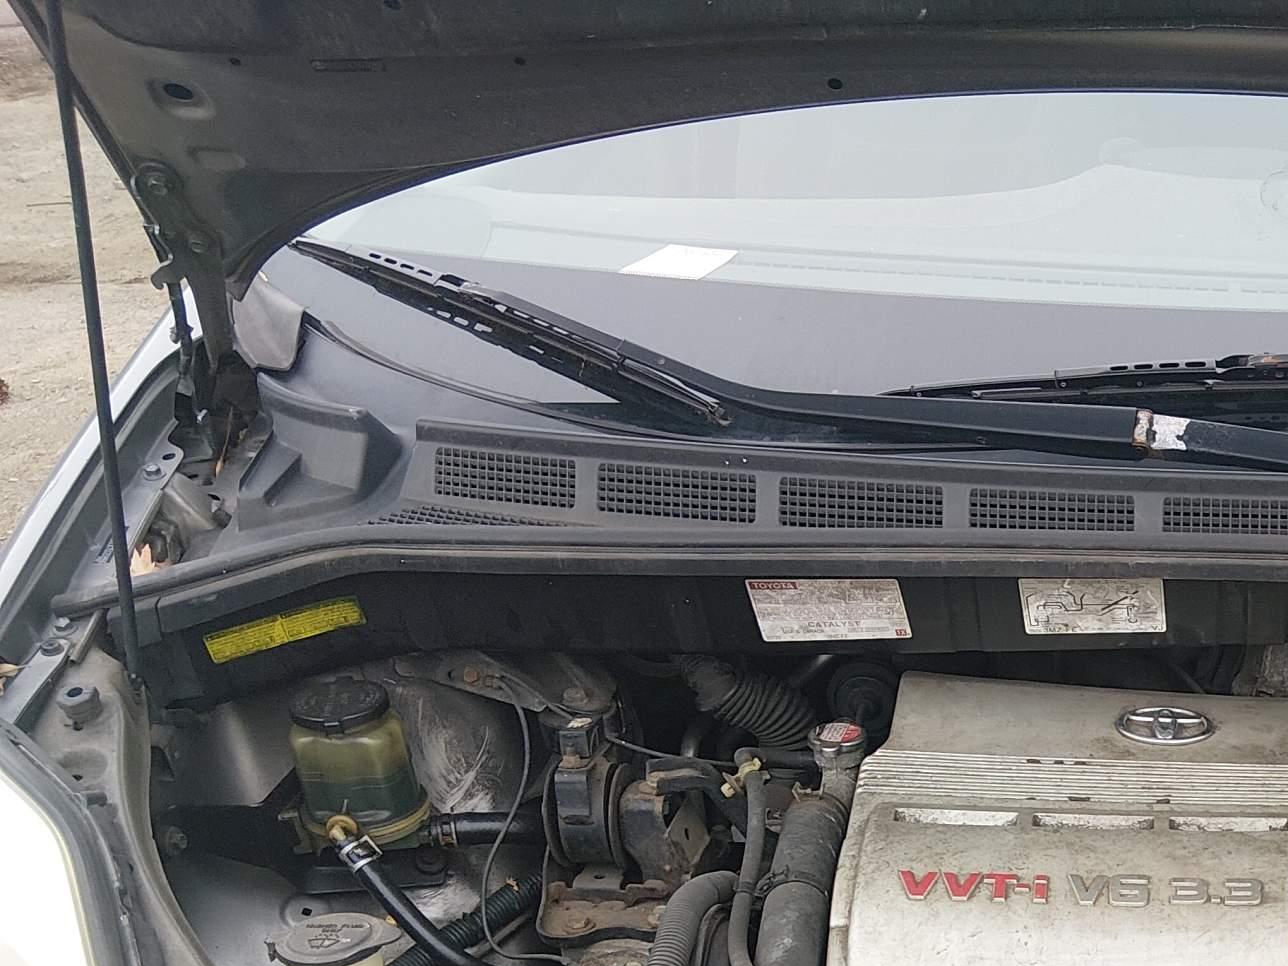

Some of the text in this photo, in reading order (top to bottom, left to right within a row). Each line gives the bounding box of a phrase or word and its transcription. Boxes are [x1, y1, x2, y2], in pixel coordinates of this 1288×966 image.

[807, 620, 861, 628] CATALYST
[900, 870, 1264, 907] VVT-i V6 3.3
